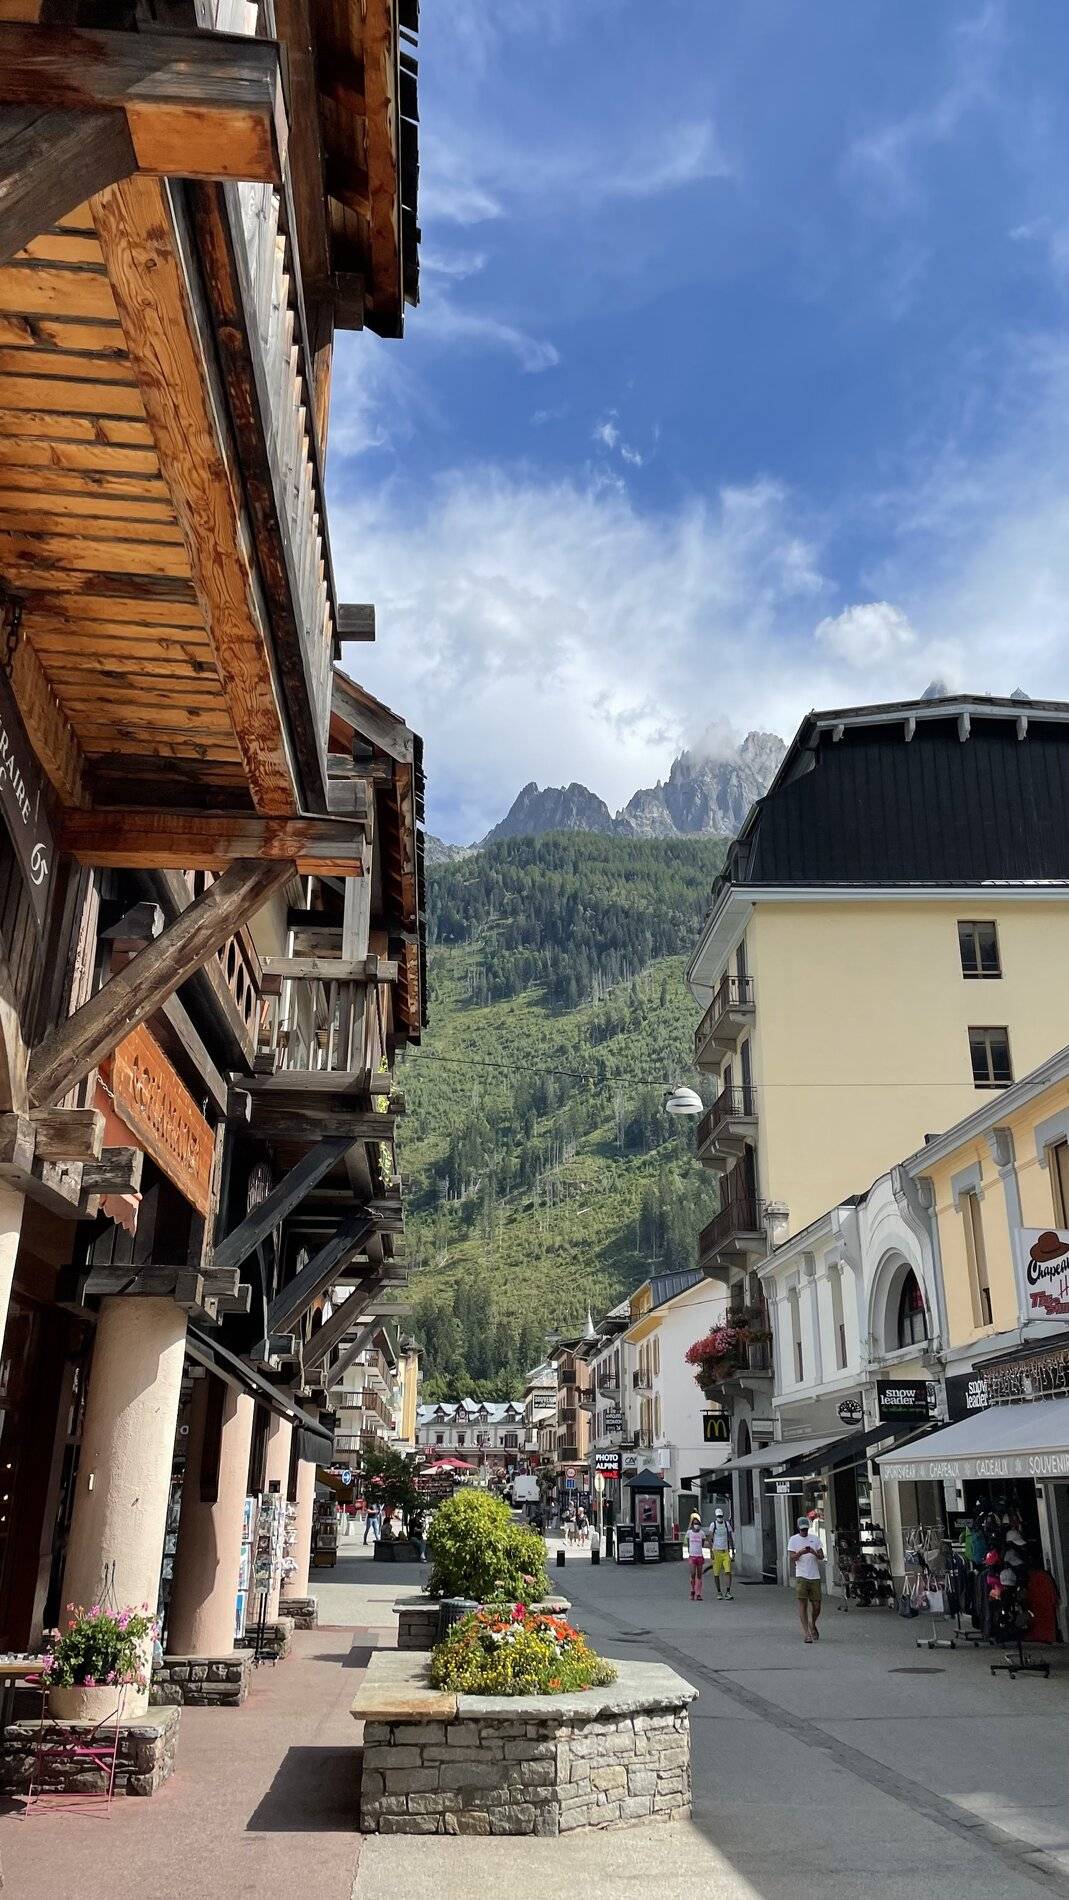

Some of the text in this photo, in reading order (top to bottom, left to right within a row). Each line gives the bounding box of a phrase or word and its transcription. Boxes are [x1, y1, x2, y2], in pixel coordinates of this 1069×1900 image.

[886, 1389, 916, 1397] snow
[880, 1395, 915, 1405] leader
[976, 1458, 1009, 1476] CADEAUX
